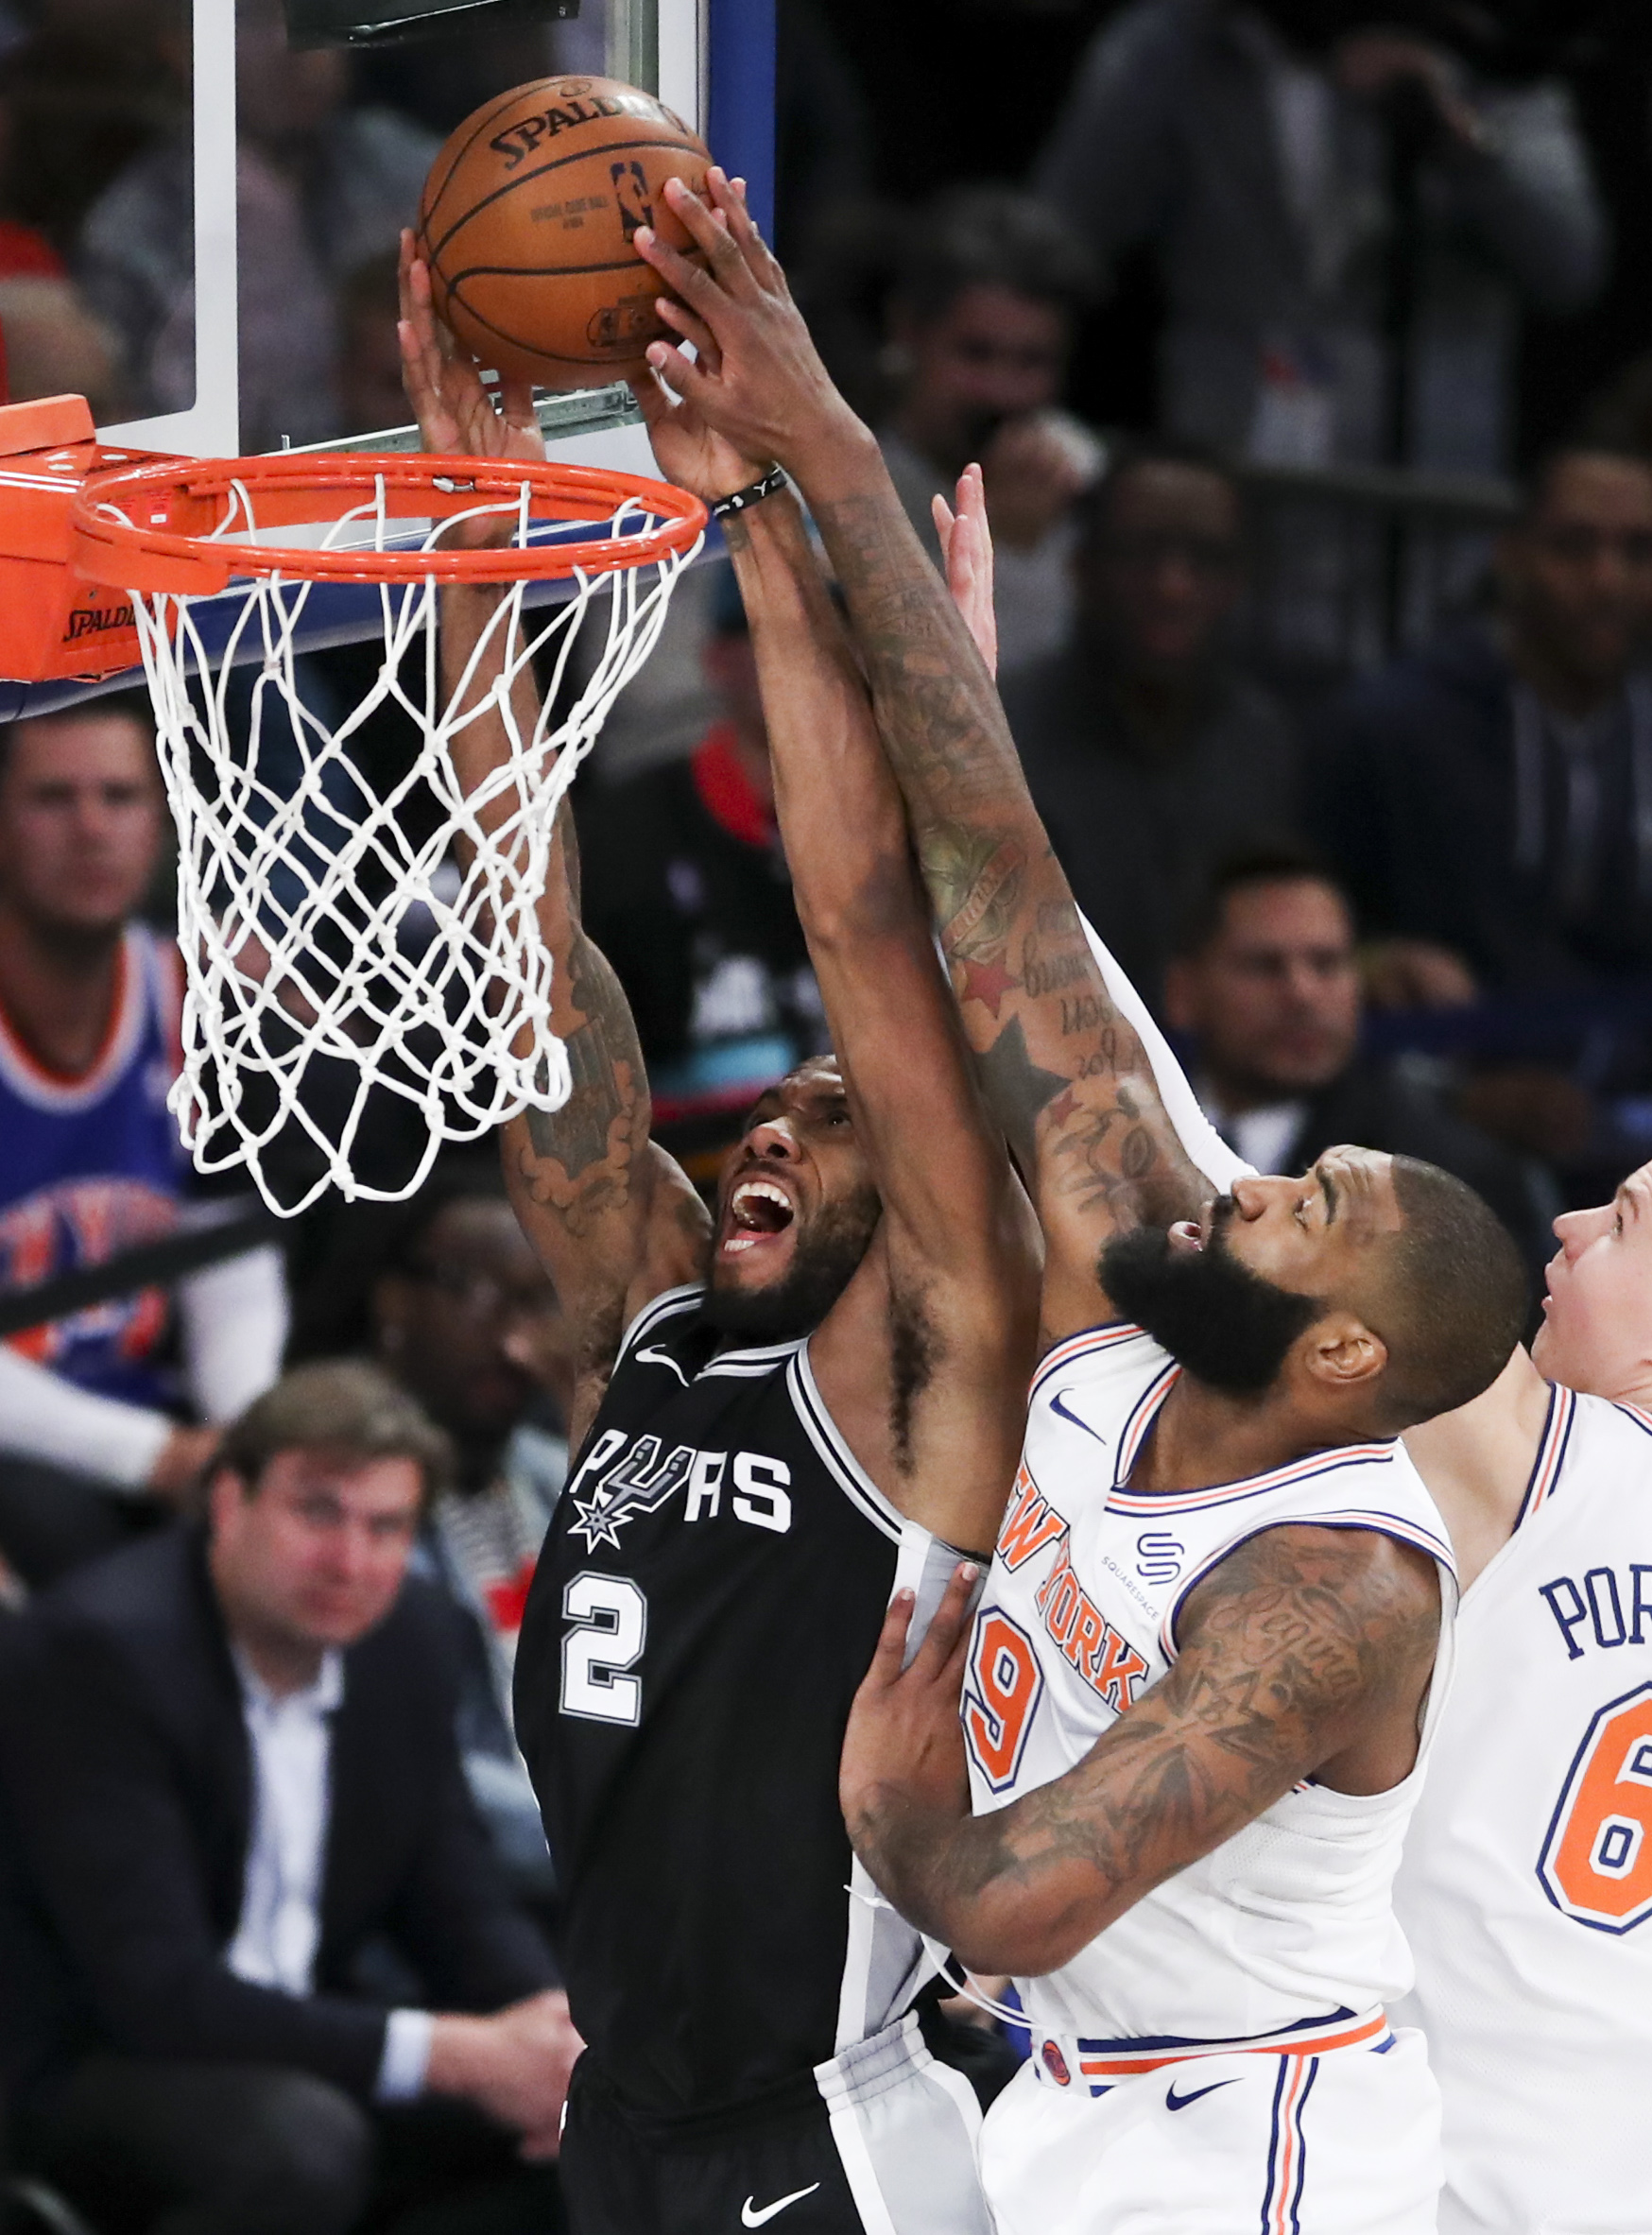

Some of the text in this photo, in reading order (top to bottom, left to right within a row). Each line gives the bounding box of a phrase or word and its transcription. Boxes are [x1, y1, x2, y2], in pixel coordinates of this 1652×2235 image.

[559, 1571, 647, 1728] 2
[1101, 1556, 1160, 1620] SQUARESPACE
[959, 1605, 1045, 1795] 9
[1535, 1680, 1652, 1935] 6
